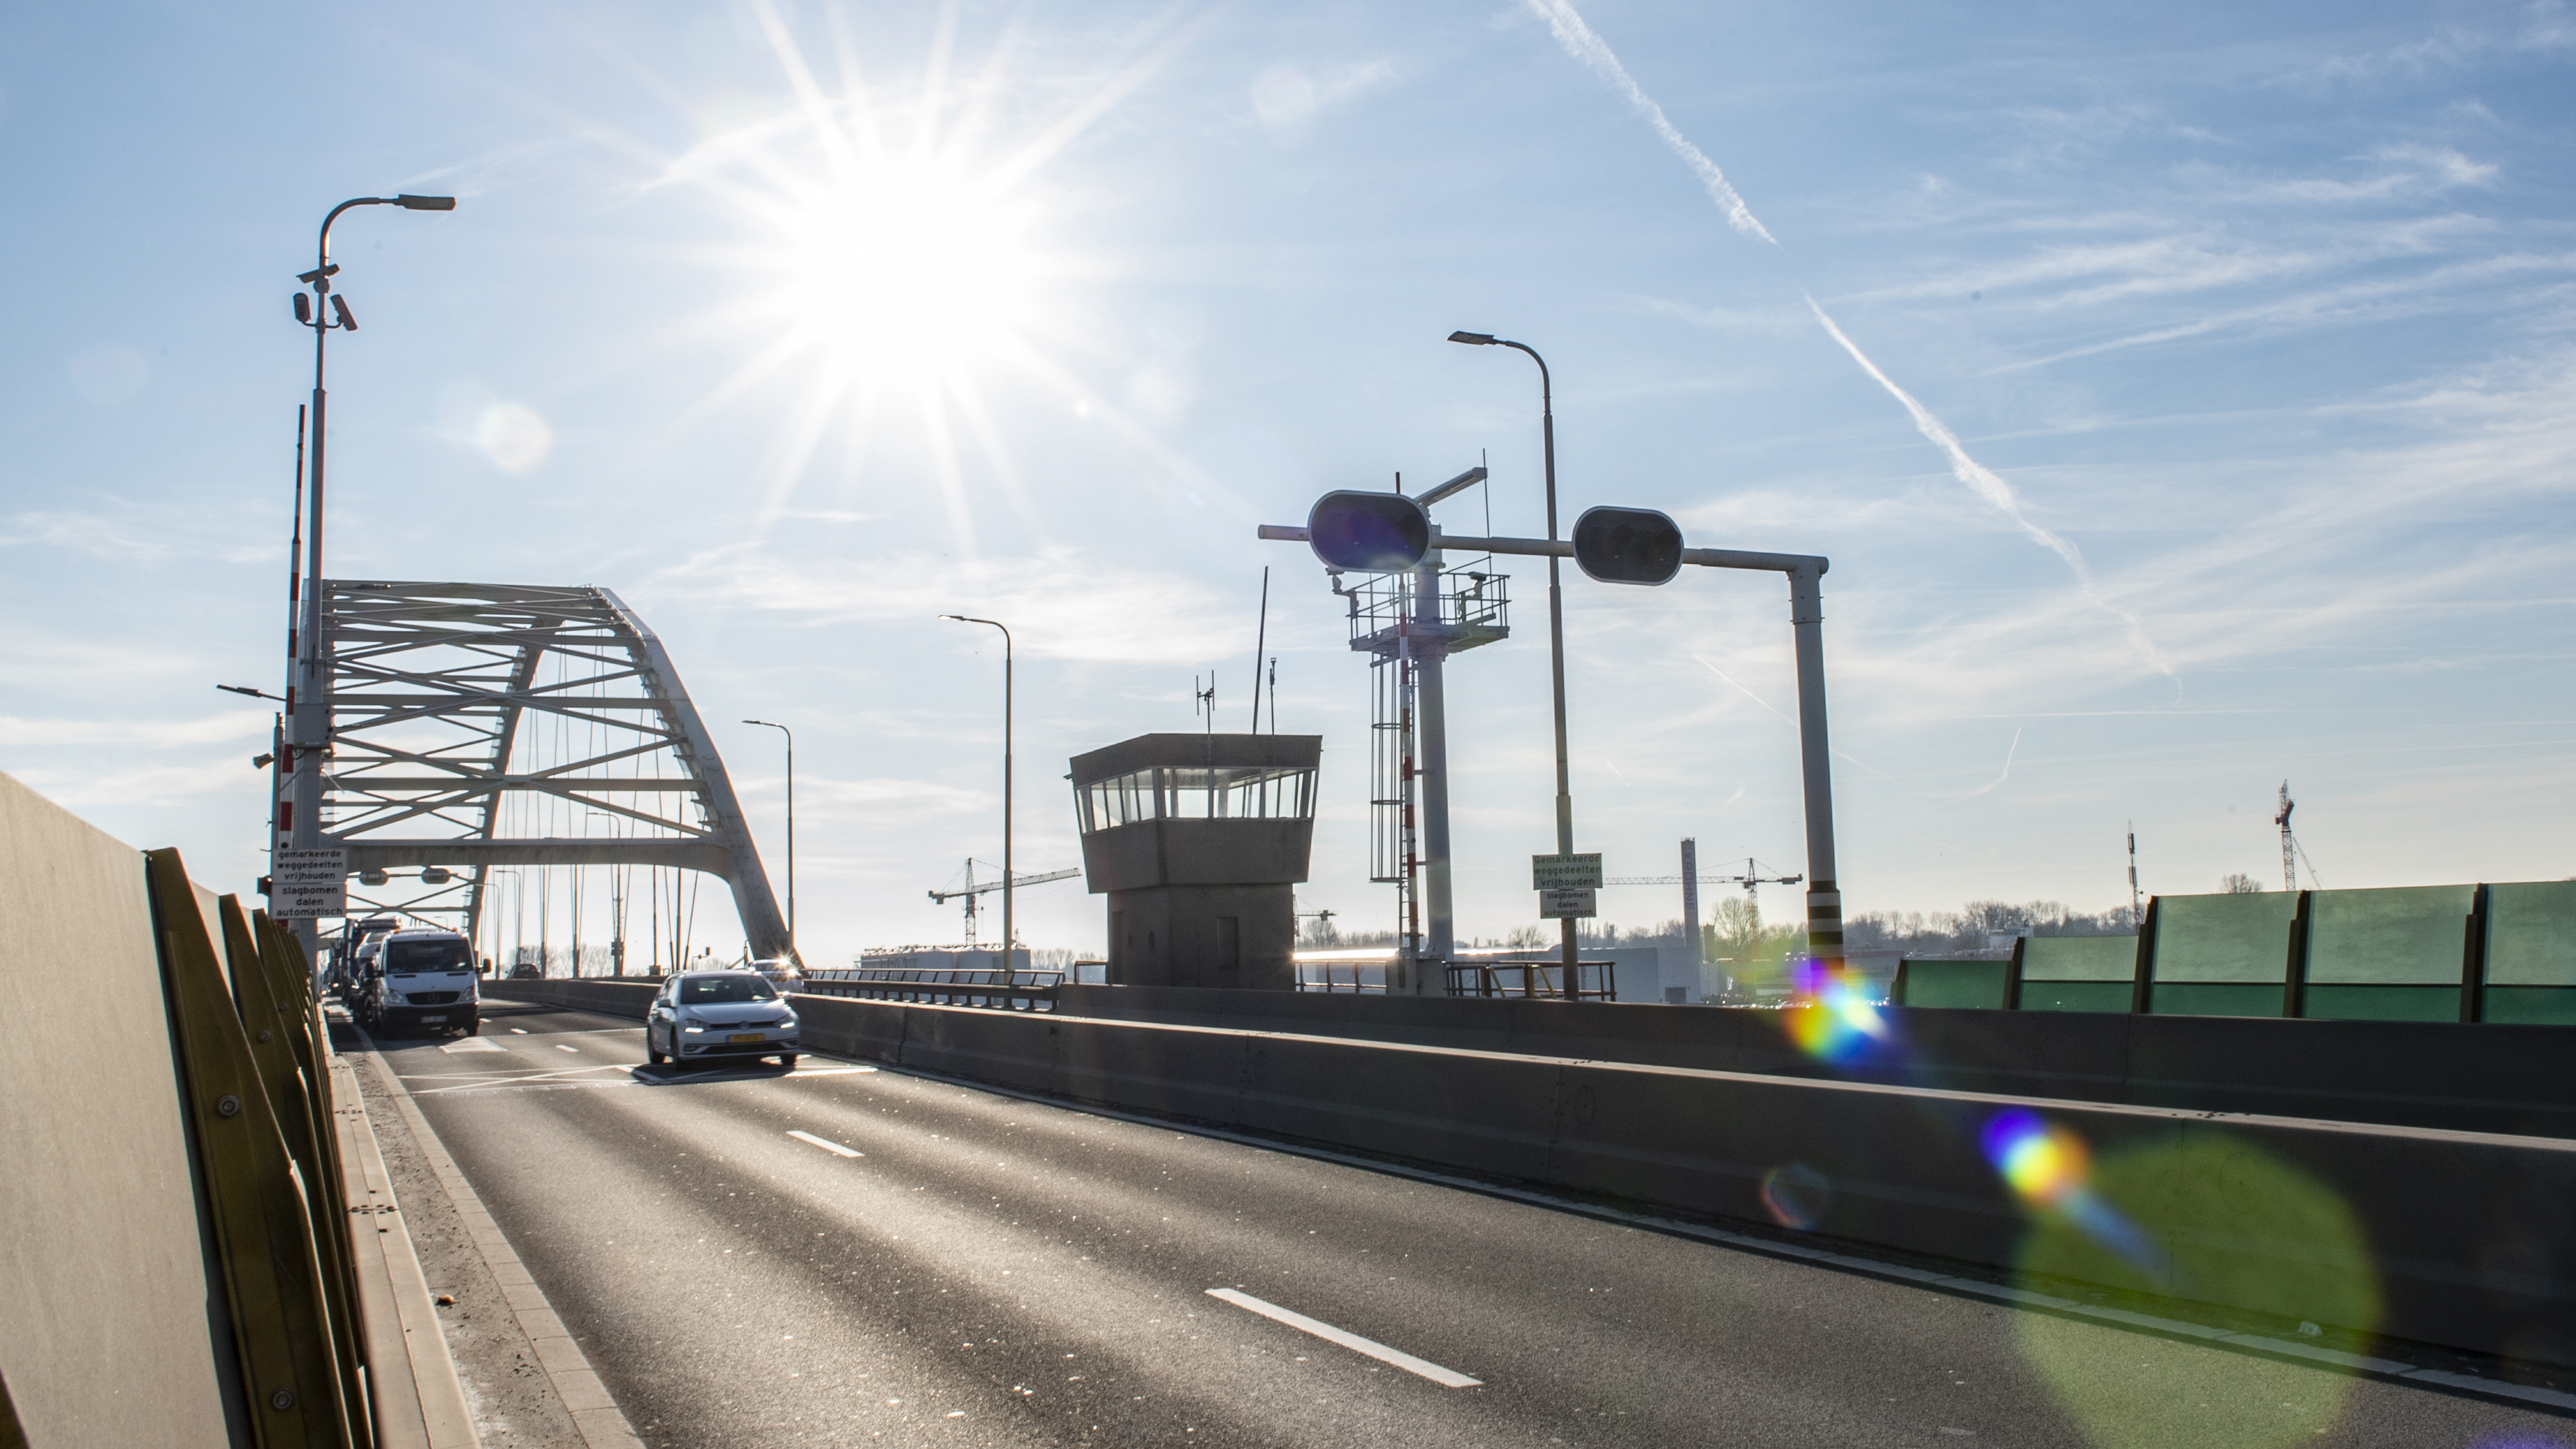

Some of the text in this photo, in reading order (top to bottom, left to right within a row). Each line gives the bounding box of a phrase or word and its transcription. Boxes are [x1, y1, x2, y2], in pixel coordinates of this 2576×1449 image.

[279, 850, 342, 860] gemarkeerde
[1534, 855, 1600, 863] Gemarkeerde
[277, 861, 342, 870] weggedeelten
[1535, 866, 1601, 876] weggedeelten
[284, 872, 335, 881] vrijhouden
[1541, 878, 1595, 888] vrijhouden
[282, 886, 338, 897] slagbomen
[1547, 892, 1589, 901] slagbomen
[296, 898, 324, 906] dalen
[277, 908, 342, 916] automatisch
